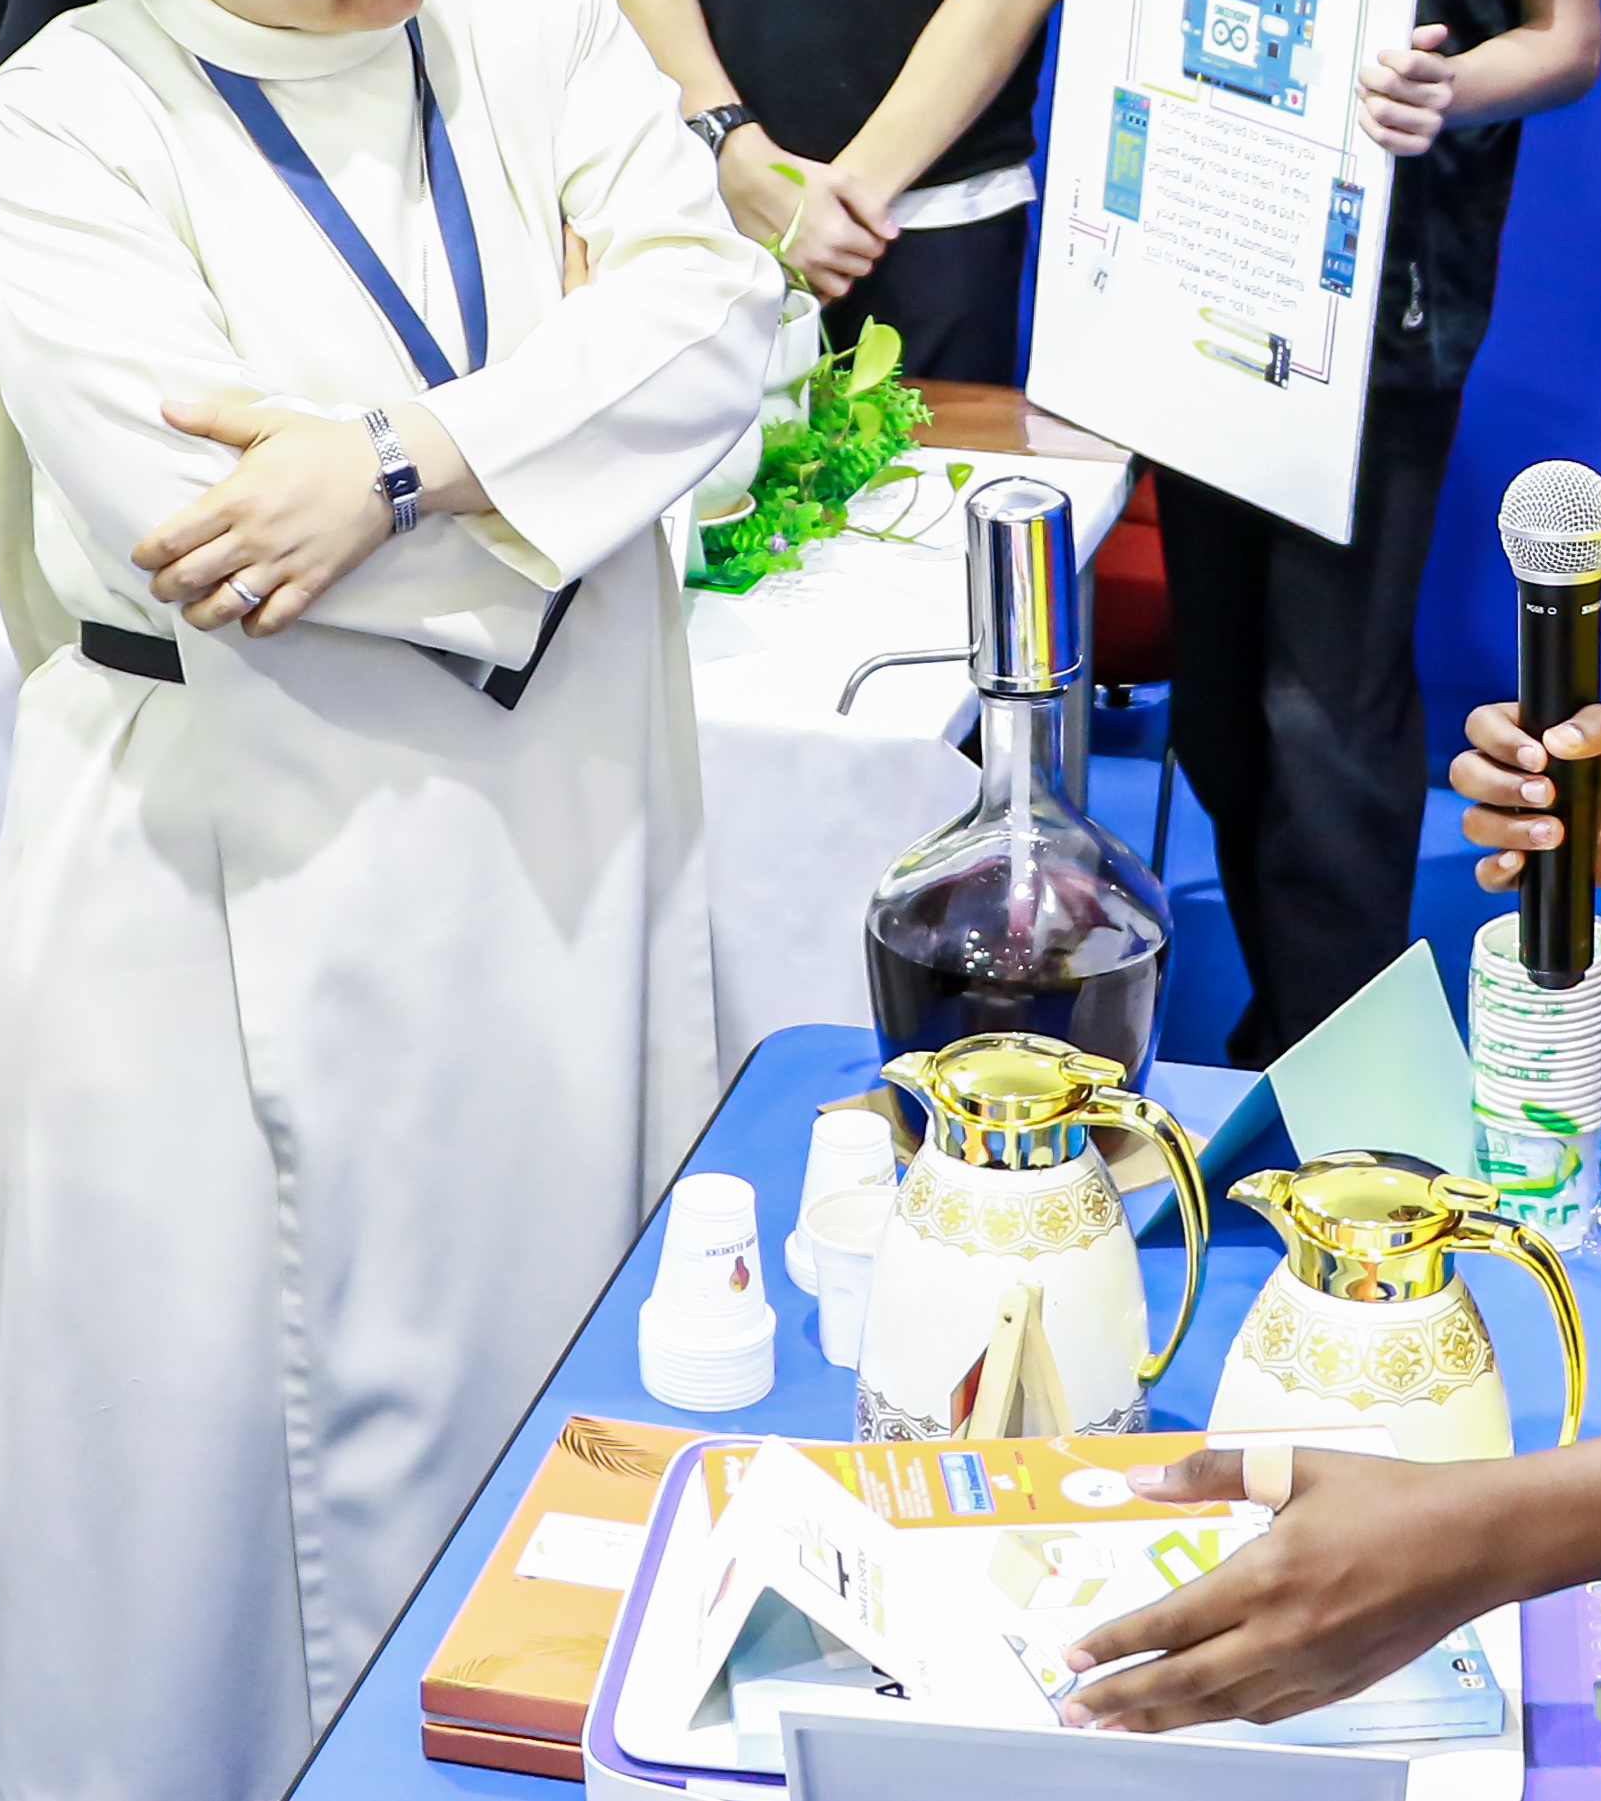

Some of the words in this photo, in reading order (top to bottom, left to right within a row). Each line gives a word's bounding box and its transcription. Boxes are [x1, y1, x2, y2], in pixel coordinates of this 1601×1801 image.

[1160, 100, 1167, 109] A
[1170, 103, 1200, 121] project
[1204, 115, 1247, 136] designed
[1250, 130, 1258, 140] to
[1299, 148, 1316, 160] you
[1183, 129, 1197, 143] the
[1201, 137, 1228, 153] stress
[1244, 153, 1286, 175] watering
[1289, 168, 1311, 180] your
[1181, 152, 1206, 170] every
[1209, 161, 1228, 174] now
[1231, 169, 1249, 182] and
[1195, 180, 1211, 191] you
[1240, 194, 1249, 205] to
[1252, 198, 1265, 210] do
[1280, 208, 1295, 221] put
[1156, 209, 1177, 220] your
[1205, 227, 1221, 238] and
[1233, 236, 1295, 268] automatically
[1252, 219, 1268, 232] the
[1272, 226, 1288, 240] soil
[1143, 220, 1177, 243] Detects
[1181, 235, 1194, 250] the
[1251, 266, 1273, 277] your
[1276, 273, 1304, 291] plants
[1176, 257, 1200, 273] know
[1204, 268, 1229, 282] when
[1232, 277, 1241, 288] to
[1244, 284, 1271, 298] water
[1272, 293, 1297, 308] them
[1201, 291, 1226, 302] when
[1229, 299, 1243, 312] not
[1247, 305, 1255, 316] to
